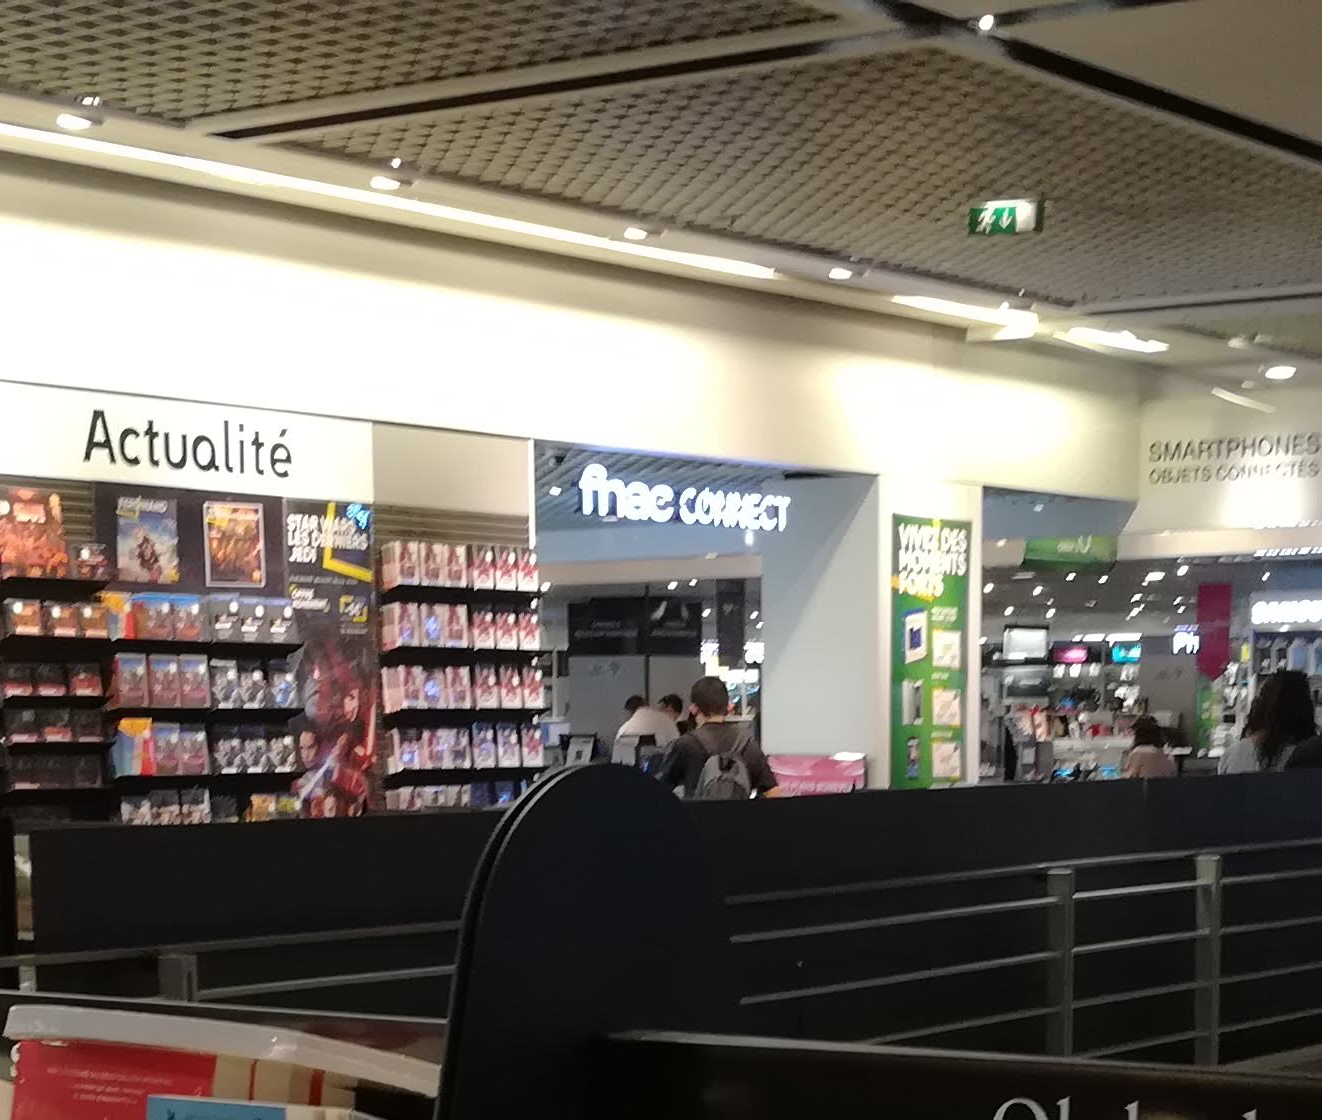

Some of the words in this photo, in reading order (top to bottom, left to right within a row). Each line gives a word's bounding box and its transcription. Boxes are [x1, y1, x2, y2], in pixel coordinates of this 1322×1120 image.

[83, 409, 293, 478] Actualité
[1149, 432, 1322, 463] SMARTPHONES
[1149, 464, 1212, 485] OBJETS
[579, 463, 677, 523] fnac
[679, 486, 791, 532] CONNECT
[897, 522, 940, 553] VIVEZ
[941, 528, 968, 554] DES
[898, 548, 968, 578] MOMENTS
